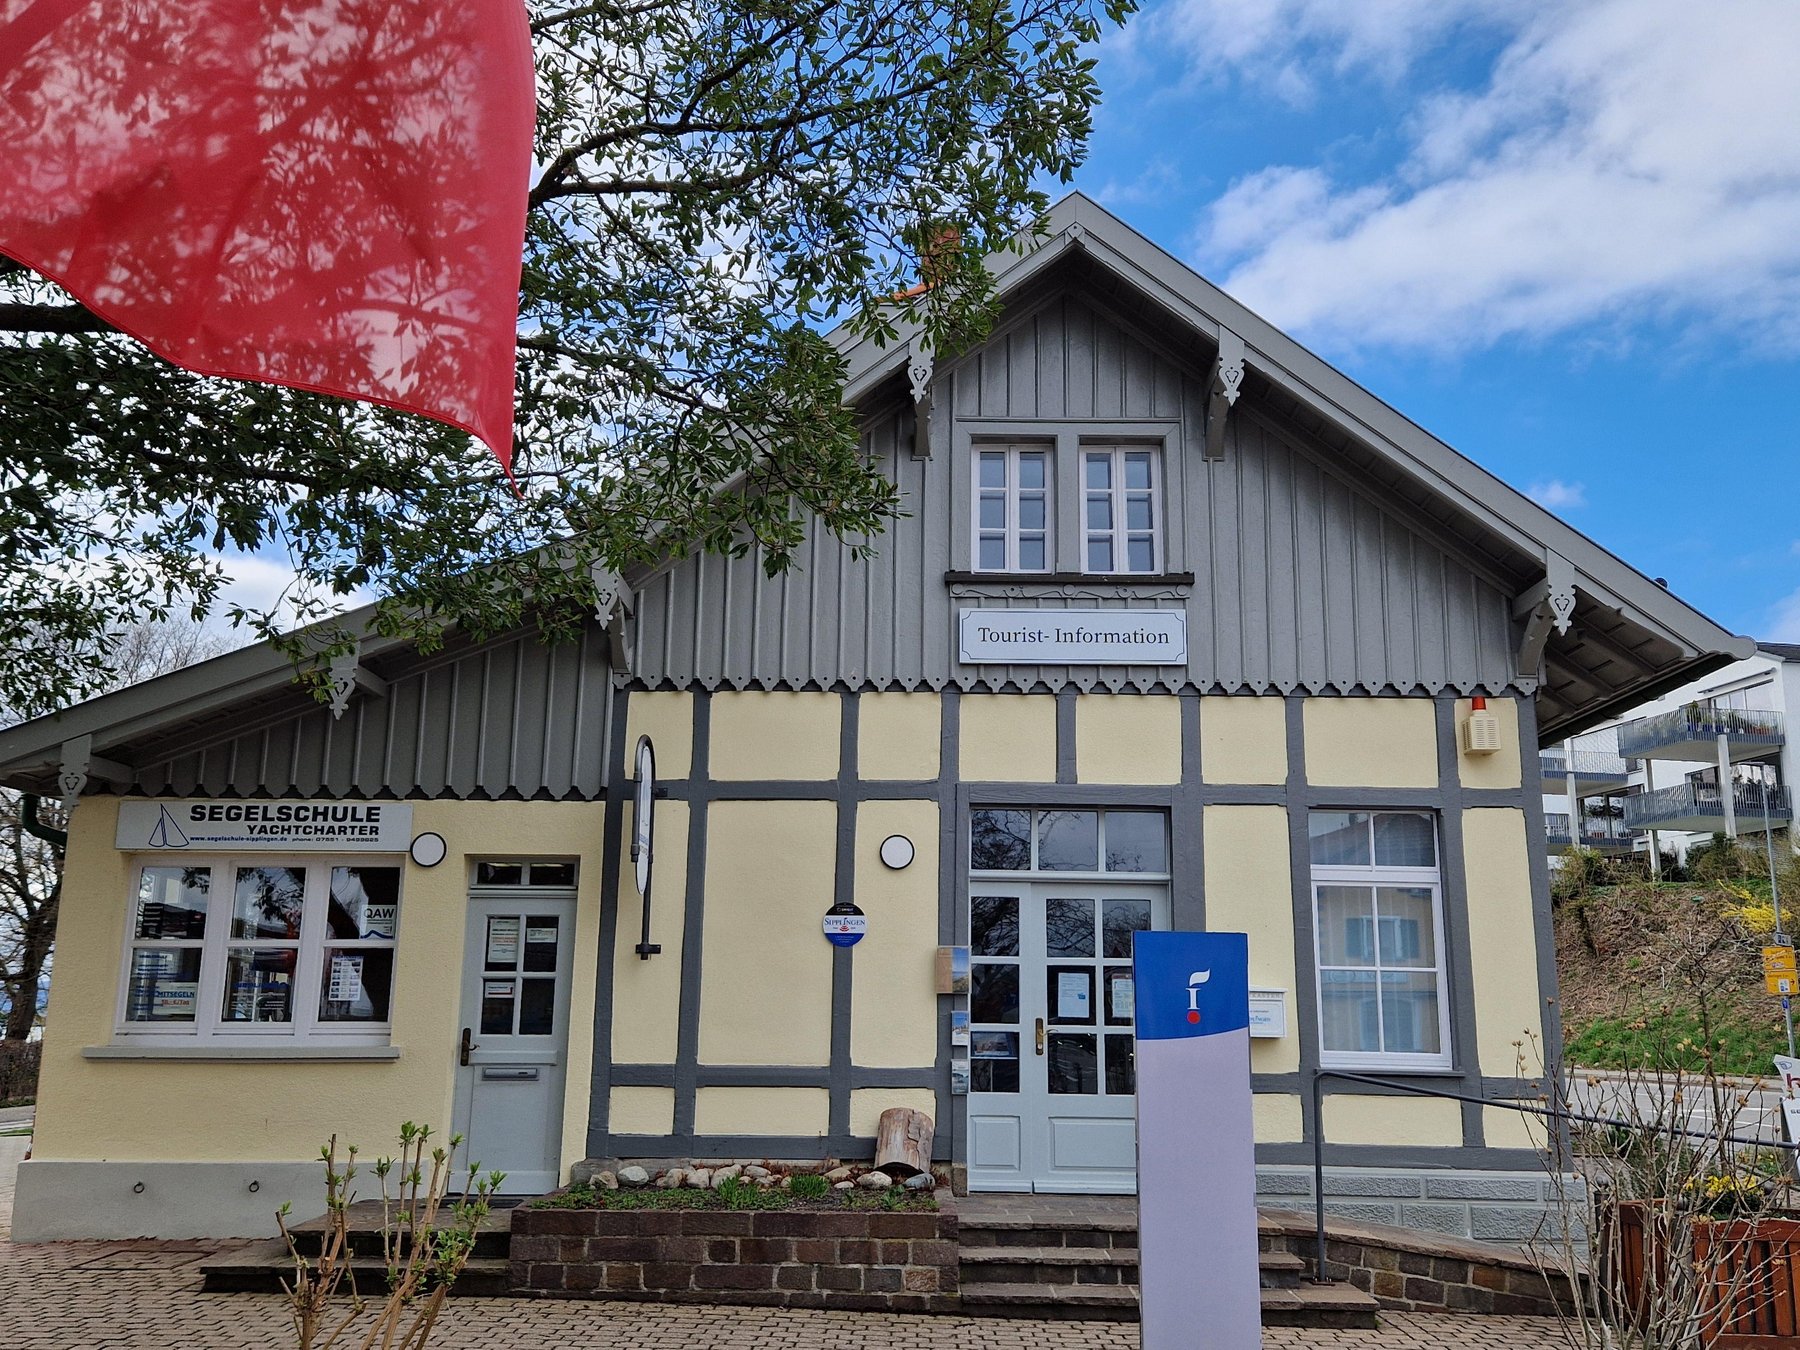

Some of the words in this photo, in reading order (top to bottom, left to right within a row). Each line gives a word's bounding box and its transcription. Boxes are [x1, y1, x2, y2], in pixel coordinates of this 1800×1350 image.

[978, 627, 1050, 643] Tourist-
[1055, 627, 1170, 644] Information
[190, 804, 381, 823] SEGELSCHULE
[247, 825, 379, 836] YACHTCHARTER
[190, 835, 287, 843] www.segelschule-sipplingen.de
[364, 908, 394, 919] QAW
